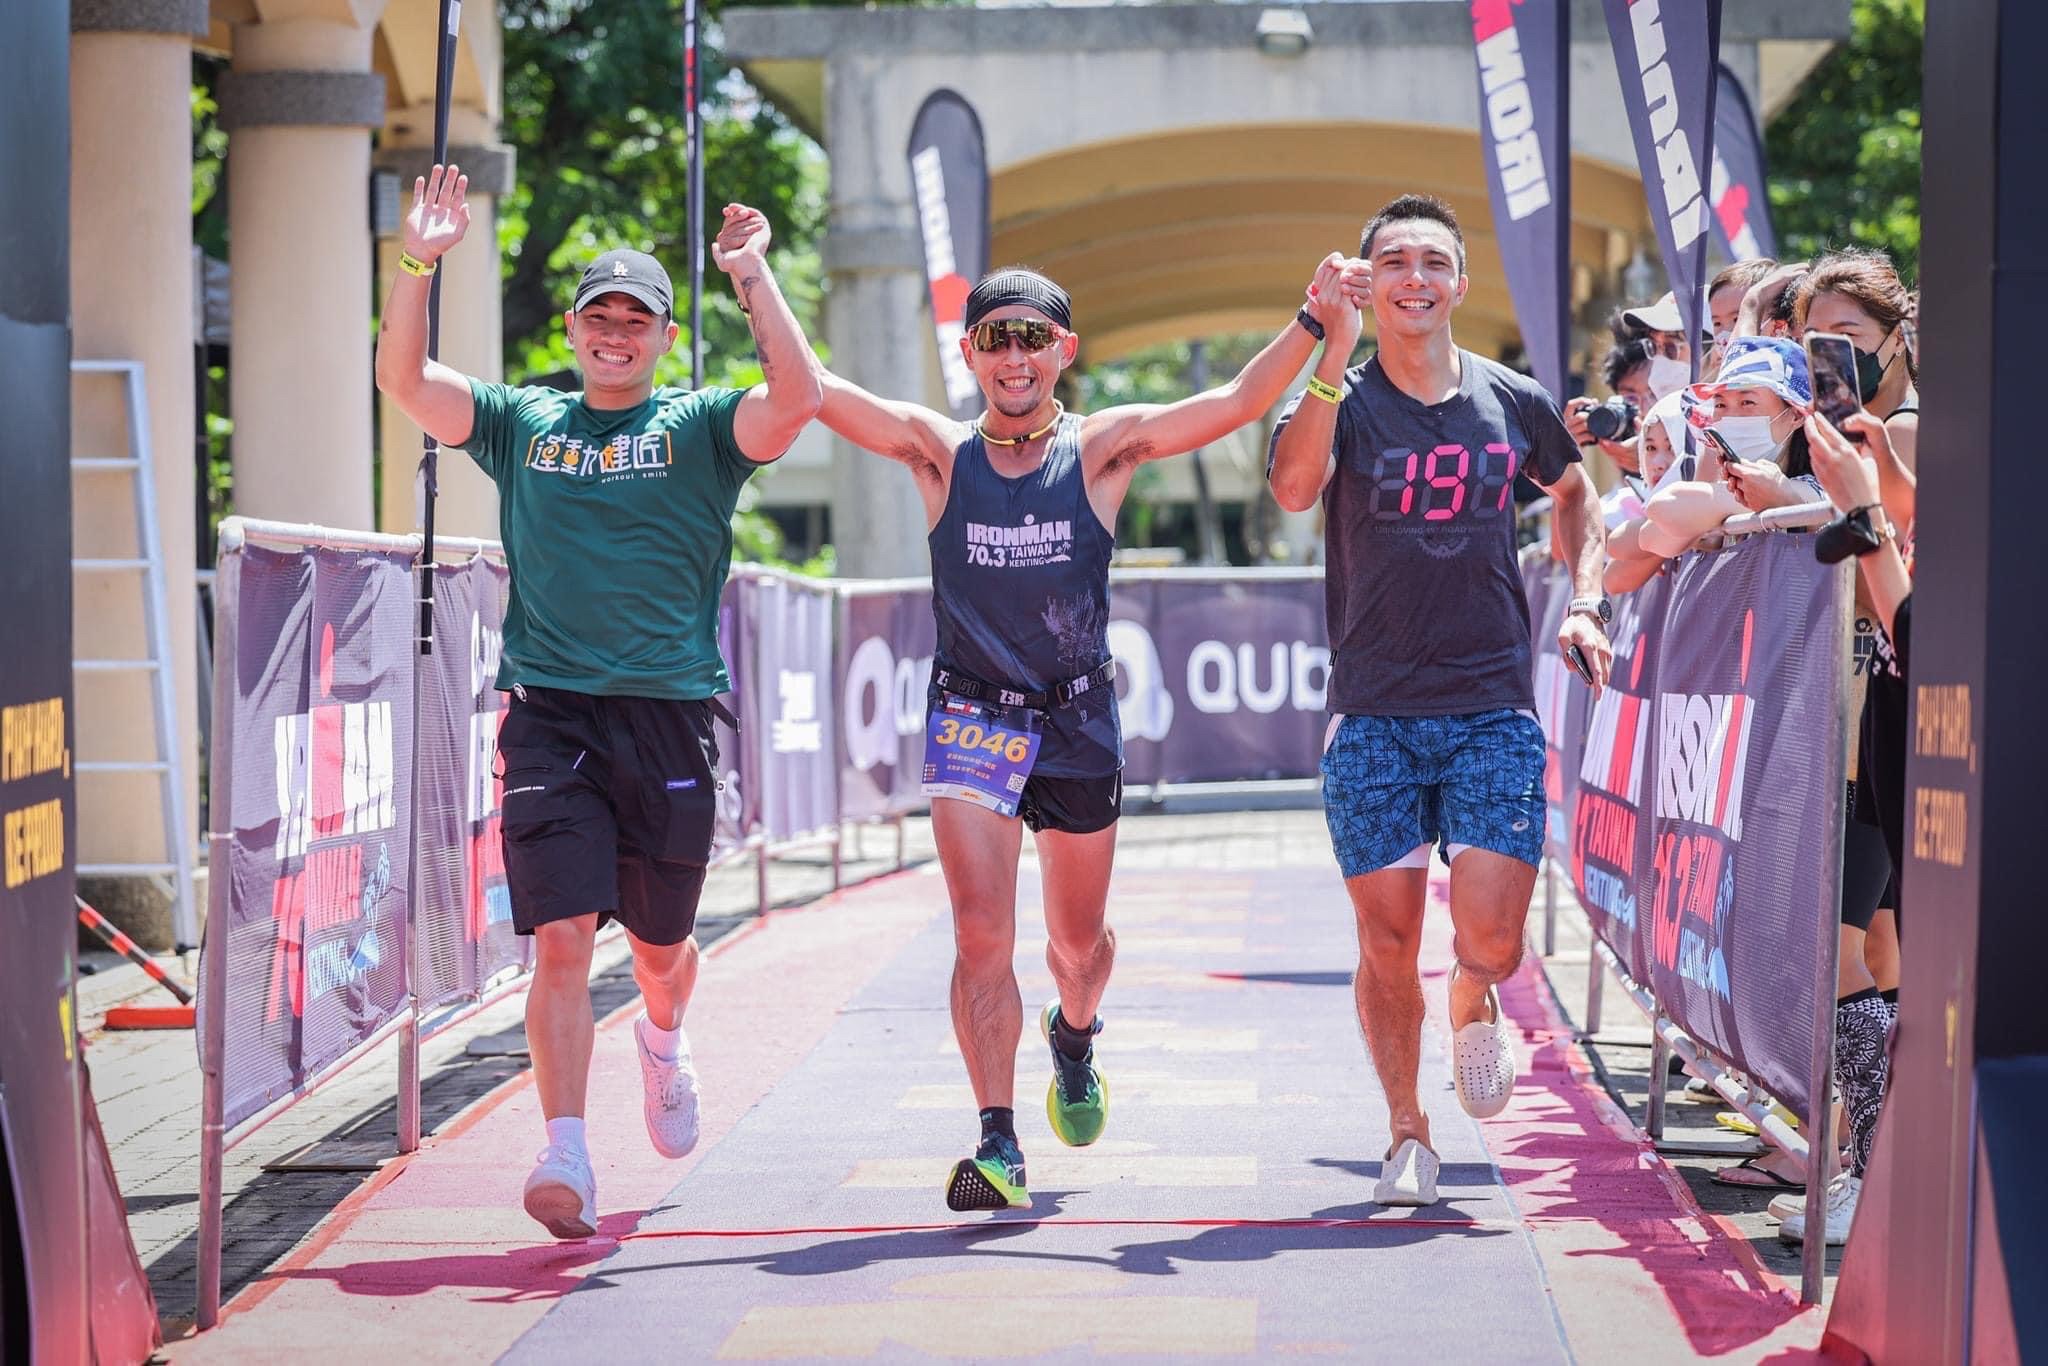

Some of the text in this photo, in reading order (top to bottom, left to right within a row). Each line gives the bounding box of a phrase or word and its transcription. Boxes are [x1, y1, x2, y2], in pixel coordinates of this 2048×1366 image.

[612, 260, 629, 276] LA
[601, 471, 668, 484] workout smith
[966, 517, 1071, 547] IRONMAN
[966, 542, 1053, 568] 70.3 TAIWAN
[1009, 557, 1046, 568] KENTING
[935, 719, 1030, 764] 3046
